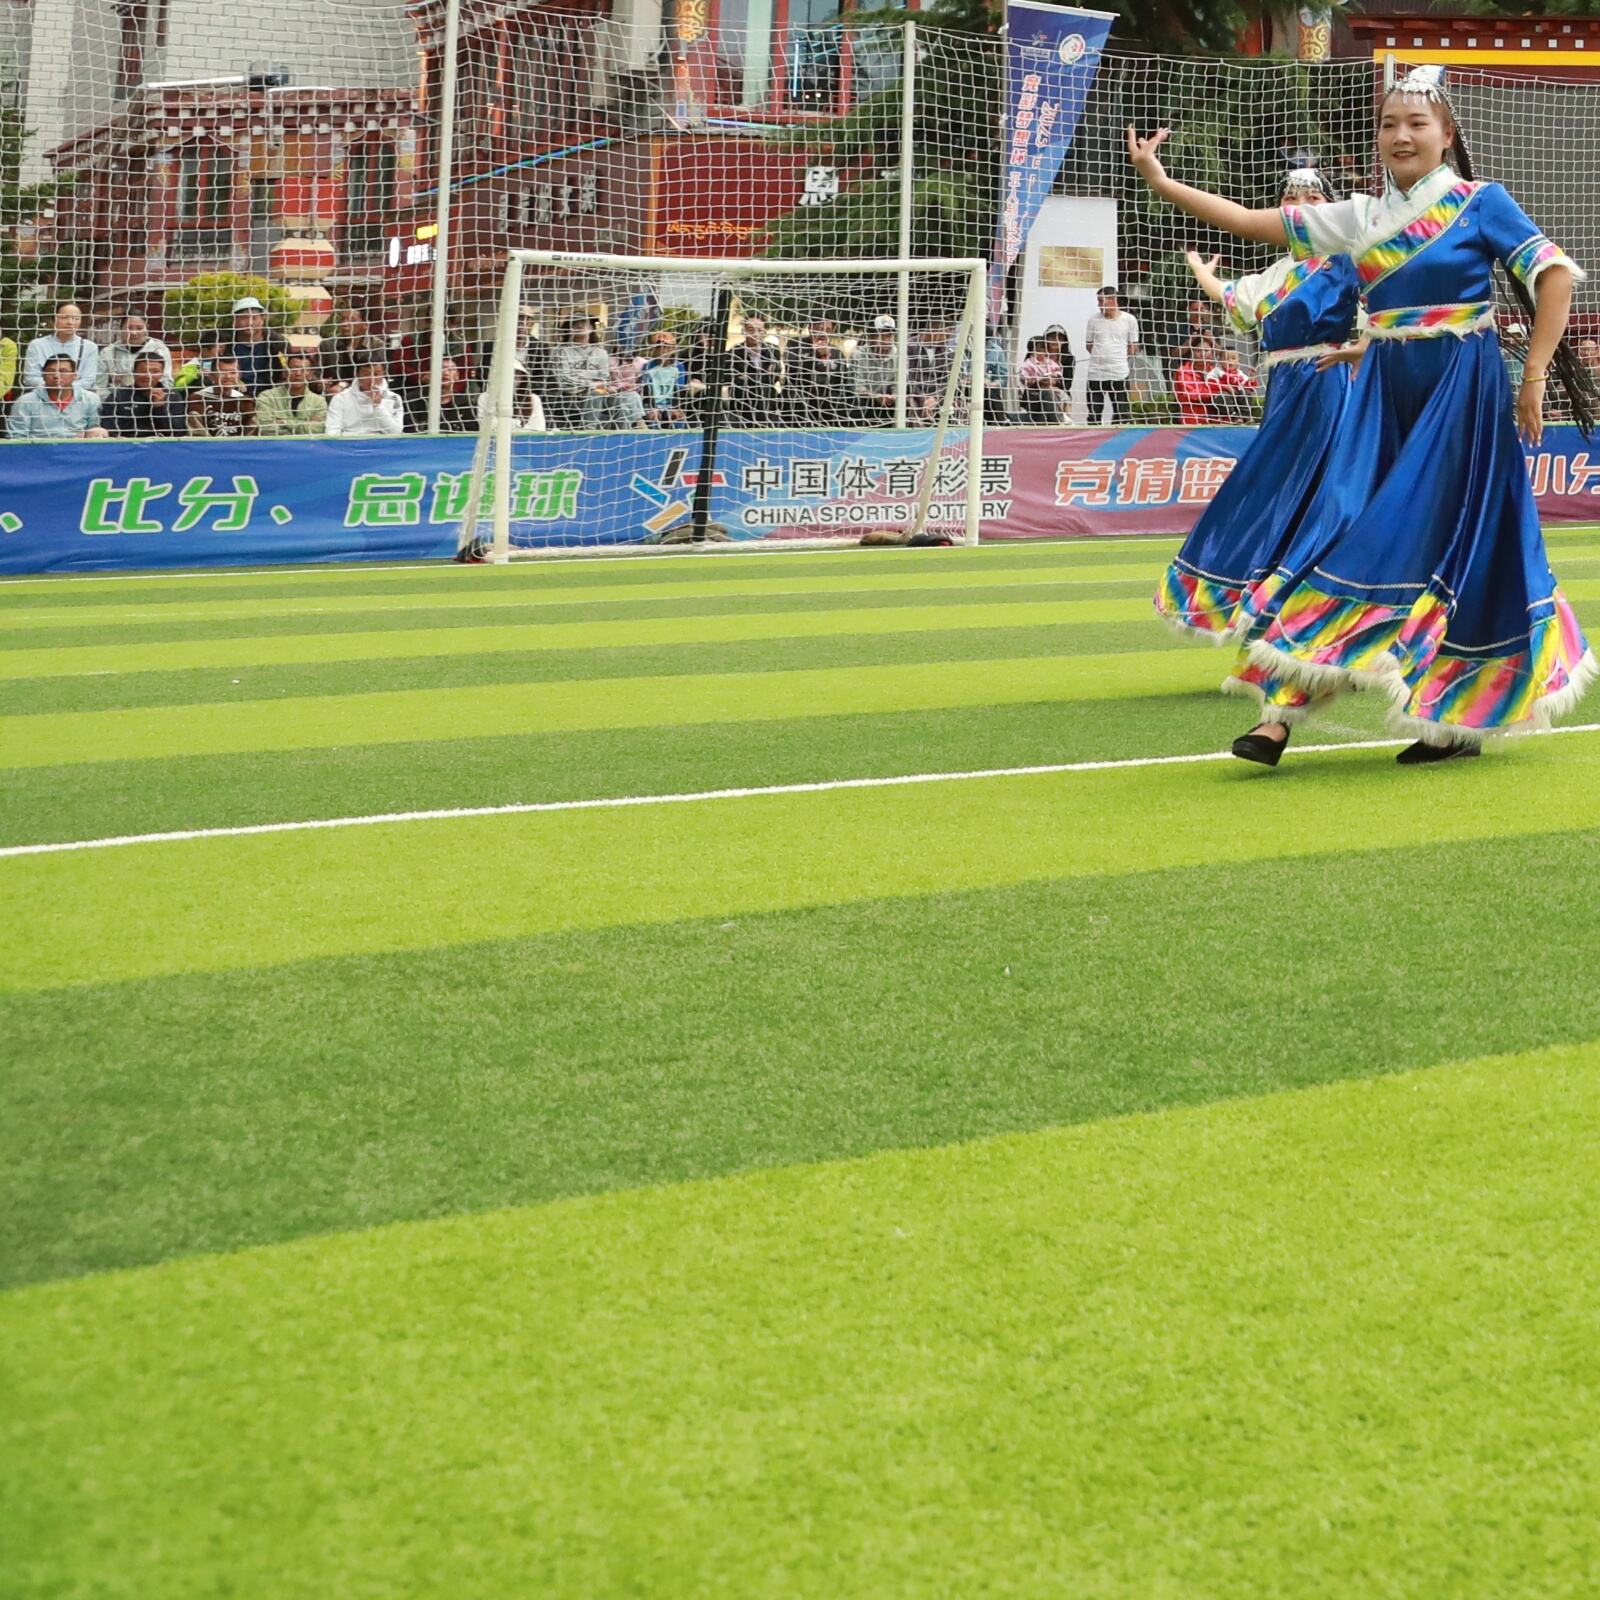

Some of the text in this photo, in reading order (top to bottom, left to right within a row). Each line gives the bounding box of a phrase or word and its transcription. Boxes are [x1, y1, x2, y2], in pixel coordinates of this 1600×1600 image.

[742, 454, 1013, 502] 中国体育彩票
[743, 499, 1013, 526] CHINA SPORTS OTTRY
